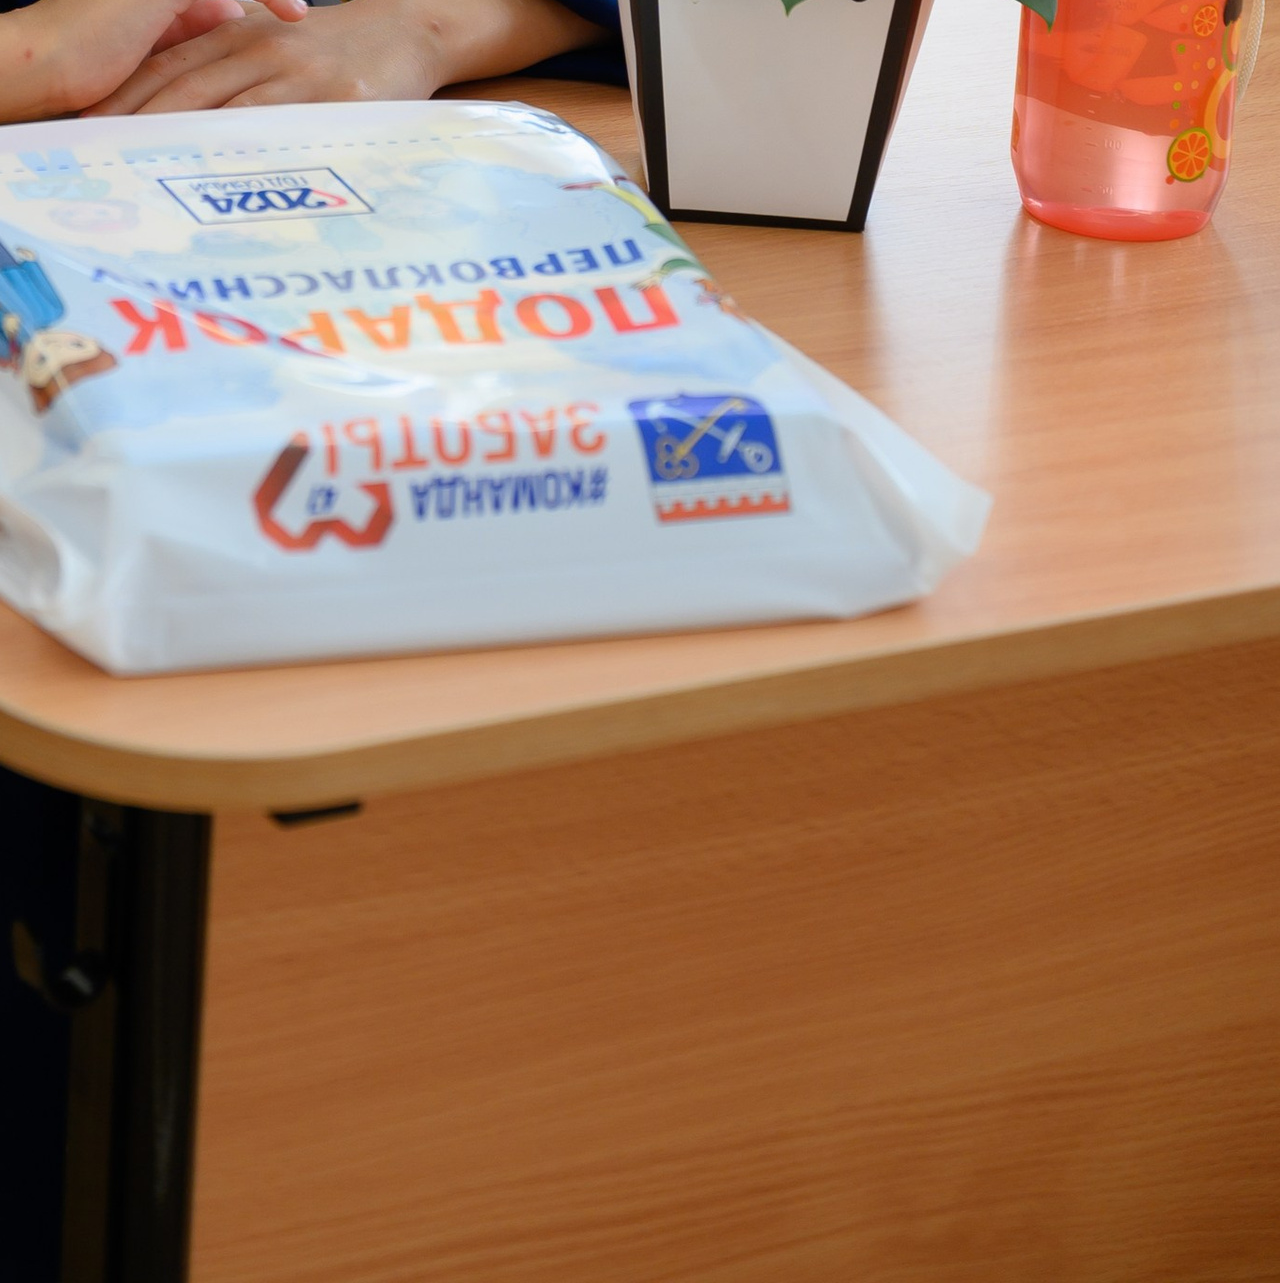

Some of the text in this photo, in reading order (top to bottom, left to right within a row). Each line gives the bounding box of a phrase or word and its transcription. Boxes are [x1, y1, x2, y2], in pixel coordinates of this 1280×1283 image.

[188, 173, 308, 192] ГОД СЕМЬИ
[200, 186, 325, 214] 2024
[89, 238, 643, 304] ПЕРВОКЛАССНИ
[106, 283, 679, 359] ПОДАРОК
[306, 485, 337, 515] 47
[408, 466, 608, 522] #КОМАНДА
